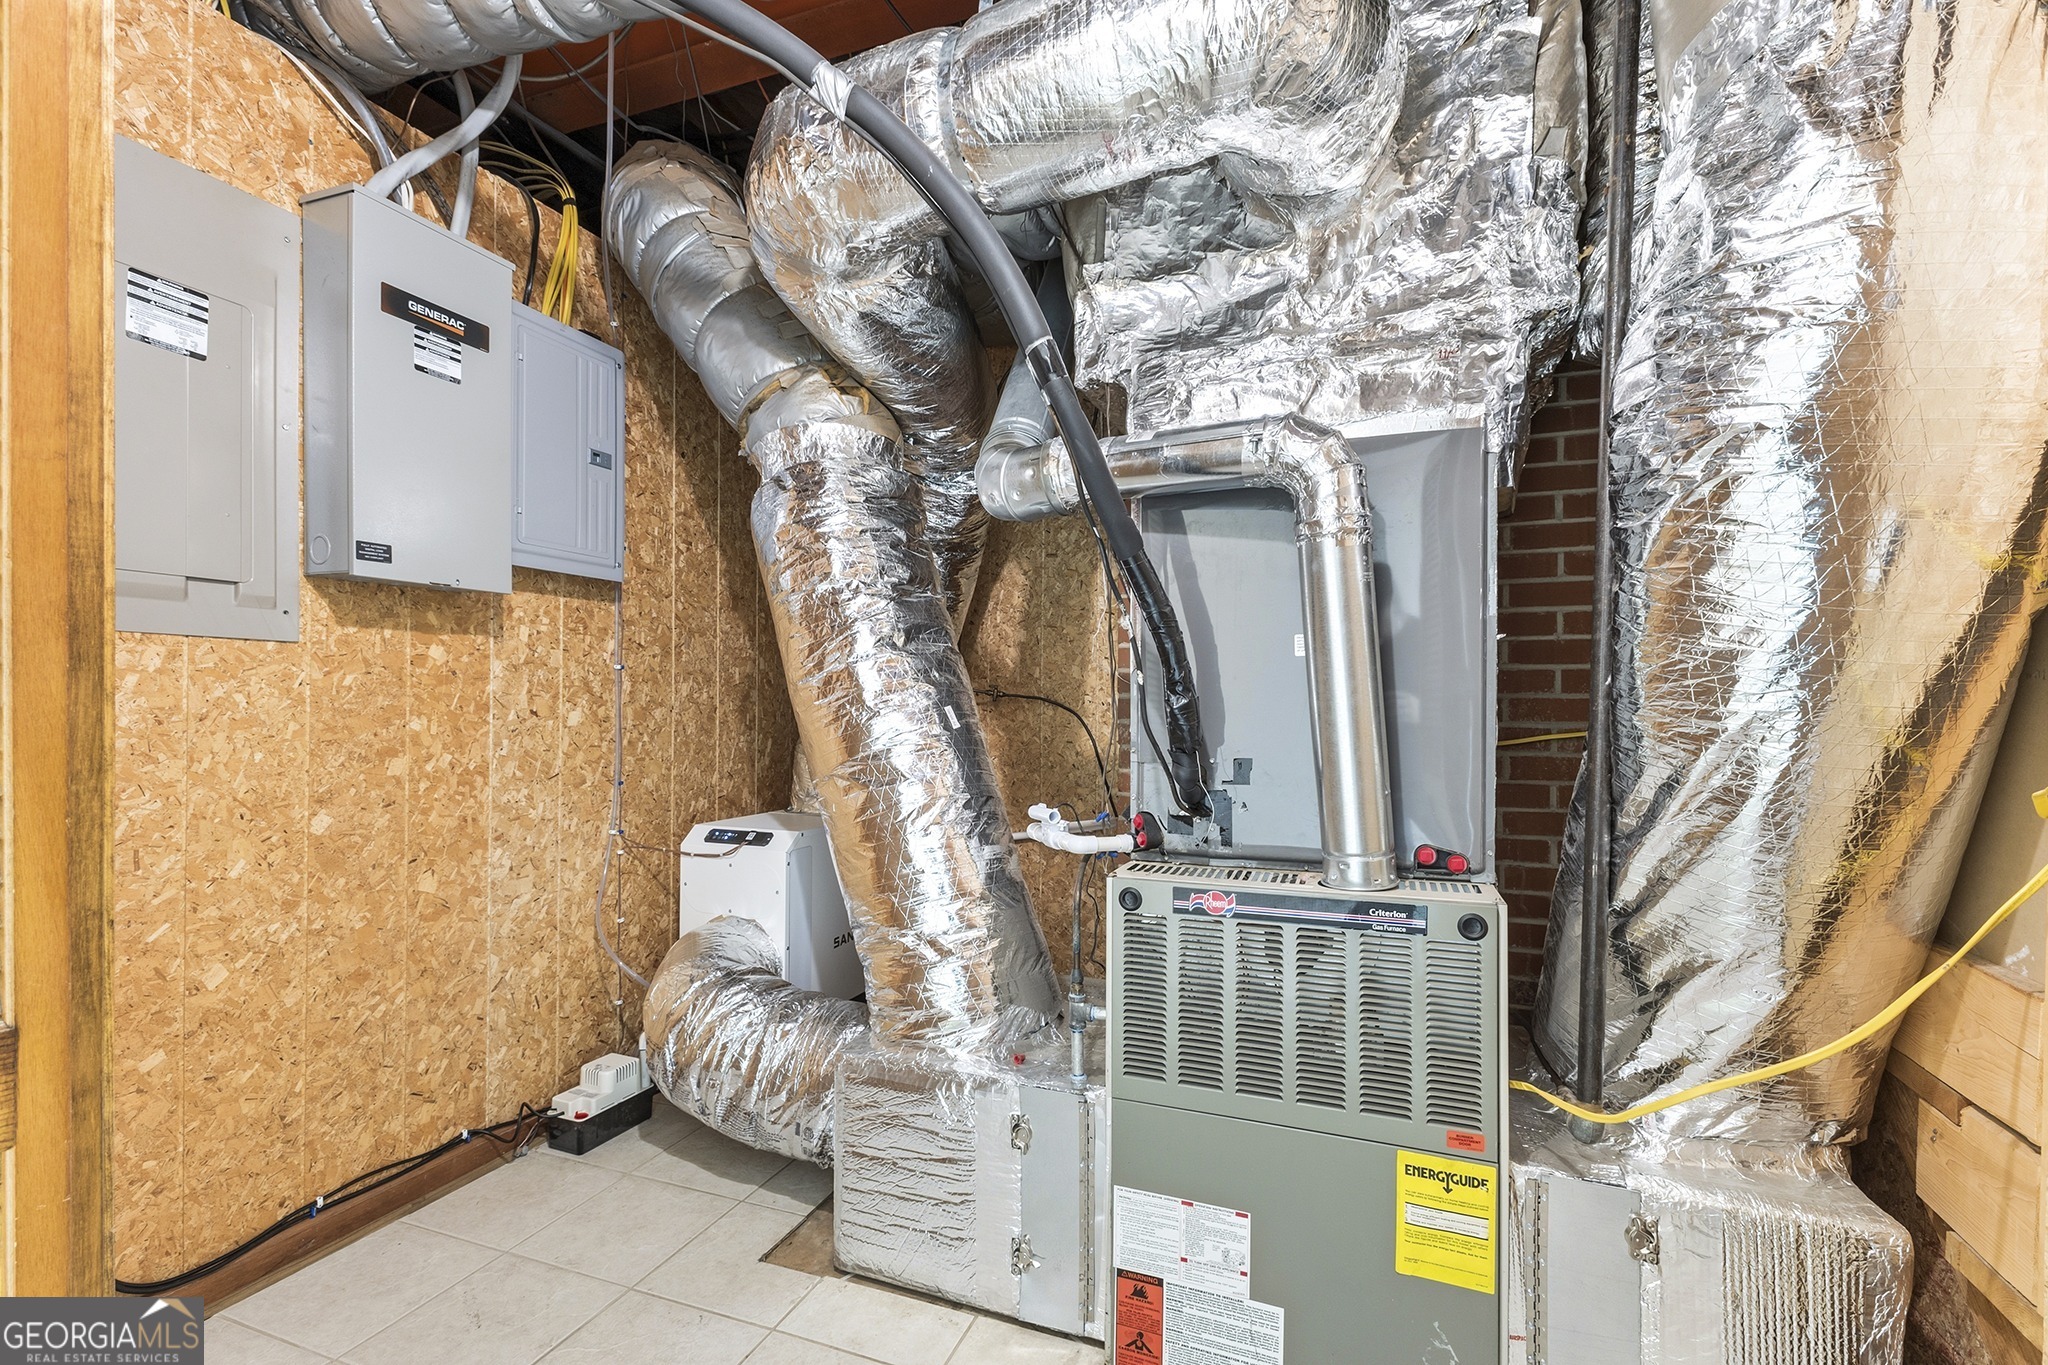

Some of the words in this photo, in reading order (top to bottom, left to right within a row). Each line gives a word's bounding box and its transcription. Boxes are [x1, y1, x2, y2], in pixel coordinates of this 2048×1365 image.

[408, 300, 465, 330] GENERAC
[1368, 908, 1407, 919] Criterion
[1371, 923, 1384, 931] Gas
[1383, 924, 1407, 933] Furnace
[1404, 1163, 1490, 1192] ENERGYGUIDE
[1127, 1271, 1159, 1285] WARNING
